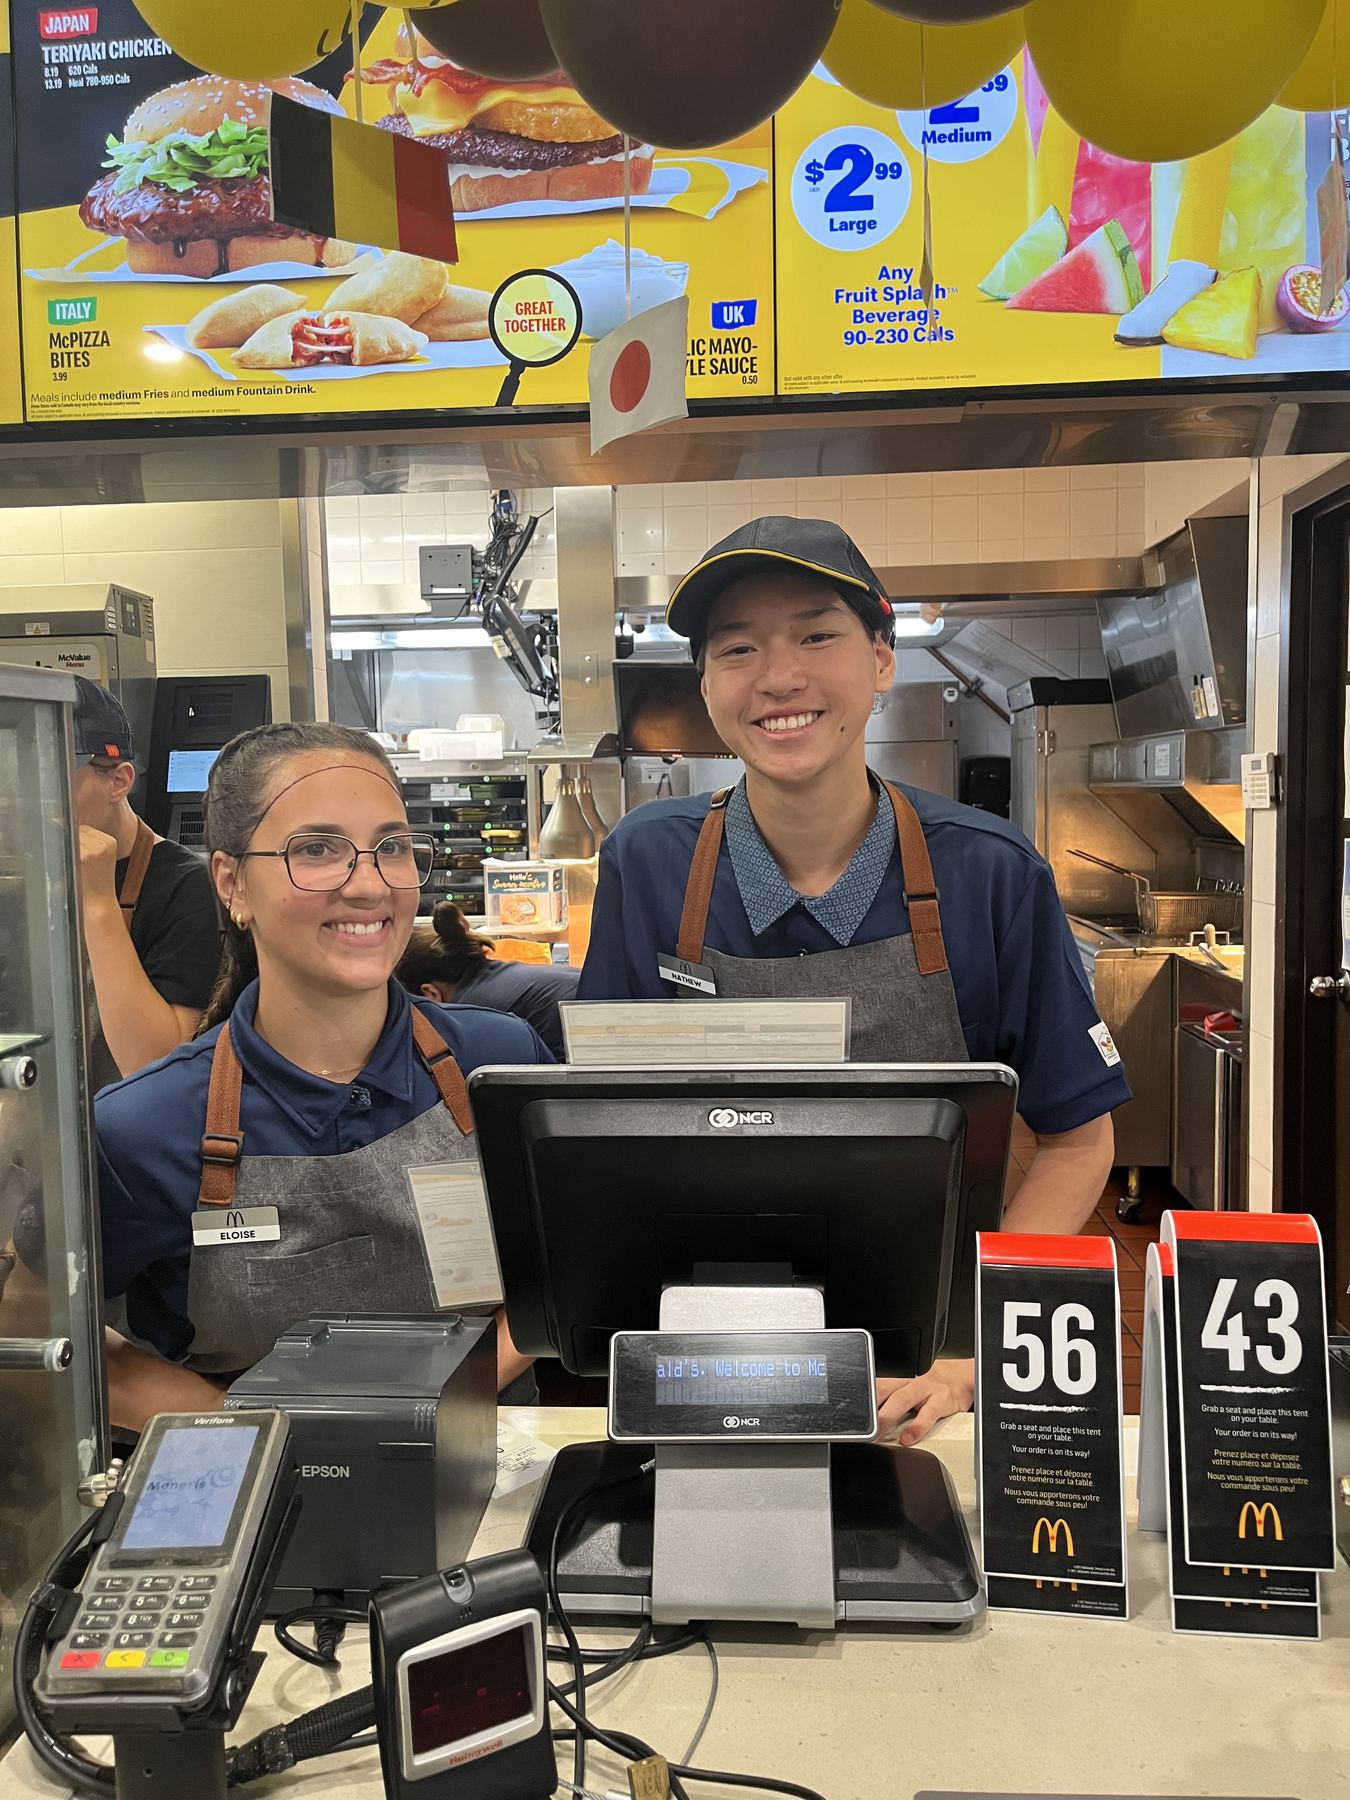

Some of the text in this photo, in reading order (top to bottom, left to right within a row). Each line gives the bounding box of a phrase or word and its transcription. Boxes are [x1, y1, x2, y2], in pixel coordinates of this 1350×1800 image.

[45, 14, 89, 34] JAPAN
[42, 38, 172, 64] TERIYAKI CHICKEN
[44, 64, 98, 77] 8.19 620 Cals
[45, 73, 130, 89] 13.19 Meal 780-950 Cals
[922, 127, 992, 144] Medium
[829, 218, 878, 234] Large
[878, 266, 914, 283] Any
[834, 286, 878, 304] Fruit
[55, 302, 92, 320] ITALY
[515, 301, 554, 316] GREAT
[722, 305, 744, 323] UK
[504, 318, 566, 333] TOGETHER
[49, 330, 110, 349] McPIZZA
[843, 326, 954, 345] 90-230 Cals
[709, 337, 757, 355] MAYO-
[50, 351, 90, 368] BITES
[710, 357, 757, 375] SAUCE
[52, 372, 68, 381] 3.99
[742, 375, 757, 384] 0.50
[31, 384, 316, 403] Meals include medium Fries and medium Fountain Drink.
[672, 972, 701, 987] NATHEW
[739, 1111, 774, 1124] NCR
[220, 1230, 256, 1240] ELOISE
[1200, 1278, 1303, 1376] 43
[1002, 1301, 1098, 1396] 56
[656, 1359, 826, 1378] ald's. Welcome to Mc
[1201, 1404, 1218, 1413] Grab
[1257, 1407, 1276, 1416] place
[1278, 1408, 1292, 1416] this
[194, 1417, 235, 1425] Verifone
[741, 1417, 760, 1426] NCR
[1259, 1416, 1279, 1424] table.
[1000, 1422, 1016, 1430] Grab
[1053, 1426, 1071, 1434] place
[1072, 1427, 1086, 1435] this
[1214, 1427, 1230, 1436] Your
[1232, 1429, 1251, 1437] order
[1270, 1431, 1279, 1439] its
[1280, 1432, 1297, 1441] way!
[1054, 1434, 1073, 1442] table.
[1012, 1444, 1027, 1453] Your
[1029, 1446, 1046, 1454] order
[1048, 1447, 1053, 1455] is
[1074, 1450, 1090, 1459] way!
[1214, 1449, 1239, 1458] Prenez
[1240, 1451, 1260, 1459] place
[1270, 1452, 1299, 1462] déposez
[1232, 1458, 1259, 1467] numéro
[1282, 1462, 1302, 1470] table.
[301, 1465, 350, 1478] EPSON
[1011, 1465, 1034, 1474] Prenez
[1036, 1467, 1054, 1476] place
[1064, 1469, 1092, 1478] déposez
[1207, 1471, 1225, 1480] Nous
[1244, 1475, 1289, 1484] apporterons
[1289, 1477, 1309, 1485] votre
[146, 1479, 206, 1491] Moneris
[1009, 1474, 1026, 1482] votre
[1027, 1475, 1053, 1484] numéro
[1055, 1477, 1065, 1485] sur
[1075, 1479, 1094, 1487] table.
[1004, 1487, 1021, 1496] Nous
[1039, 1491, 1081, 1500] apporterons
[1221, 1482, 1296, 1493] commande sous peu!
[1016, 1497, 1054, 1507] commande
[1073, 1501, 1088, 1509] peu!
[105, 1579, 111, 1588] 1
[144, 1578, 153, 1587] 2
[185, 1576, 194, 1586] 3
[93, 1597, 103, 1606] 4
[136, 1596, 144, 1606] 5
[179, 1595, 187, 1605] 6
[85, 1615, 95, 1626] 7
[128, 1615, 137, 1624] 8
[172, 1614, 180, 1623] 9
[120, 1634, 129, 1644] 0
